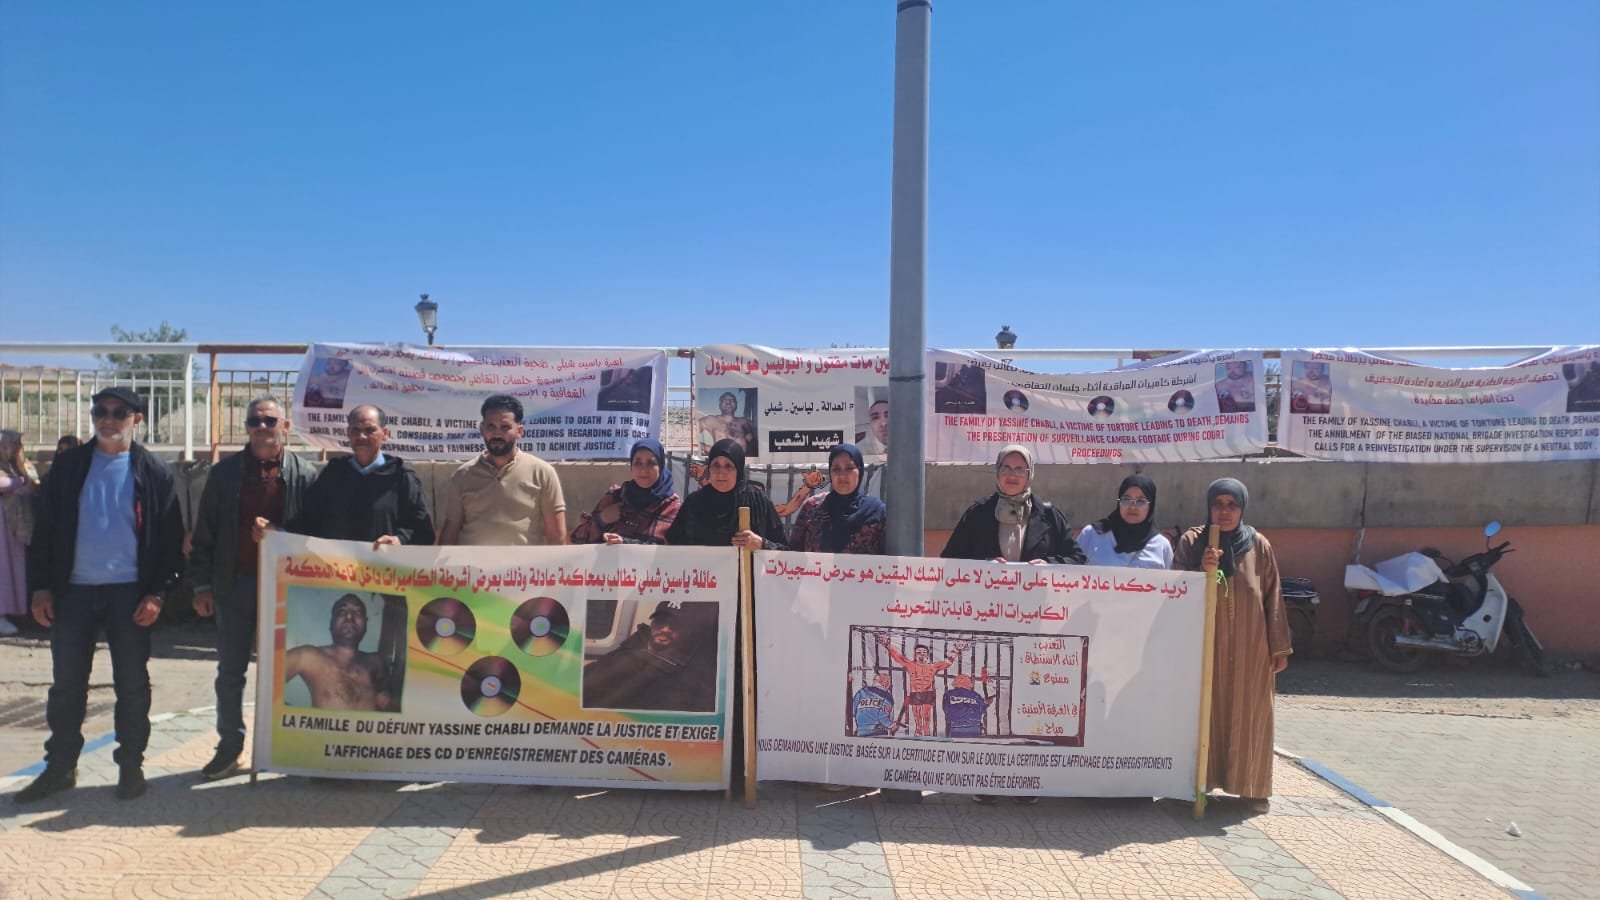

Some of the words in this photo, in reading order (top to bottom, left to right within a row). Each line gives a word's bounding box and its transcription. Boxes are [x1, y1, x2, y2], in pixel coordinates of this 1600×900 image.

[746, 360, 760, 374] هو
[762, 354, 803, 375] البوليس
[806, 362, 812, 374] و
[814, 354, 848, 374] مقتول
[850, 354, 872, 370] مات
[1102, 380, 1136, 391] المراقبة
[1138, 377, 1170, 389] كاميرات
[764, 400, 784, 416] شبلي
[790, 401, 814, 415] لياسين
[821, 400, 846, 412] العدالة
[308, 412, 320, 422] THE
[436, 418, 442, 428] A
[444, 418, 478, 429] VICTIME
[529, 416, 562, 425] LEADING
[564, 416, 575, 425] TO
[578, 416, 602, 425] DEATH
[607, 416, 616, 425] AT
[619, 416, 634, 426] THE
[945, 416, 958, 426] THE
[960, 416, 986, 427] FAMILY
[987, 417, 997, 428] OF
[999, 417, 1029, 428] YASSINE
[1066, 422, 1094, 431] VICTIME
[1096, 423, 1105, 431] OF
[1106, 422, 1139, 432] TORTURE
[1142, 420, 1173, 431] LEADING
[1175, 418, 1185, 428] TO
[1187, 416, 1211, 427] DEATH
[1302, 416, 1317, 425] THE
[1318, 416, 1345, 426] FAMILY
[1347, 417, 1357, 426] OF
[1360, 417, 1390, 427] YASSINE
[1460, 420, 1469, 428] OF
[1472, 418, 1506, 428] TORTURE
[1508, 416, 1537, 426] LEADING
[1539, 416, 1548, 426] TO
[396, 431, 443, 440] CONSIDERS
[568, 428, 612, 438] REGARDING
[614, 428, 629, 438] HIS
[774, 432, 808, 450] الشعب
[812, 432, 840, 450] شهيد
[967, 431, 981, 442] THE
[982, 431, 1038, 442] PRESENTATION
[1040, 432, 1049, 443] OF
[1051, 433, 1105, 444] SURVEILLANCE
[1106, 434, 1136, 444] CAMERA
[1138, 433, 1171, 444] FOOTAGE
[1174, 432, 1200, 442] DURING
[1202, 430, 1225, 440] COURT
[1308, 430, 1322, 438] THE
[1376, 430, 1386, 440] OF
[1388, 431, 1403, 440] THE
[1405, 431, 1432, 440] BIASED
[1434, 432, 1470, 440] NATIONAL
[1472, 431, 1504, 440] BRIGADE
[1504, 429, 1554, 440] INVESTIGATION
[428, 444, 444, 453] AND
[448, 443, 484, 453] FAIRNESS
[536, 442, 546, 452] TO
[549, 442, 582, 451] ACHIEVE
[584, 442, 616, 450] JUSTICE
[1314, 442, 1338, 451] CALLS
[1340, 443, 1355, 452] FOR
[1365, 443, 1432, 453] REINVESTIGATION
[1433, 444, 1458, 453] UNDER
[1460, 444, 1474, 453] THE
[1476, 444, 1522, 453] SUPERVISION
[1524, 443, 1533, 452] OF
[285, 556, 333, 579] المحكمة
[334, 562, 356, 584] قاعة
[360, 565, 382, 587] داخل
[765, 559, 822, 580] تسجيلات
[823, 564, 856, 582] عرض
[860, 568, 874, 584] هو
[875, 564, 912, 584] اليقين
[914, 566, 944, 582] الشك
[973, 568, 983, 585] لا
[383, 566, 436, 592] الكاميرات
[439, 565, 471, 592] أشرطة
[472, 568, 502, 593] بعرض
[503, 567, 527, 592] وذلك
[529, 568, 556, 587] عادلة
[558, 568, 606, 592] بمحاكمة
[607, 568, 636, 592] تطالب
[638, 568, 661, 594] شبلي
[662, 569, 691, 594] ياسين
[692, 568, 717, 589] عائلة
[946, 568, 971, 588] على
[985, 570, 1022, 591] اليقين
[1023, 572, 1048, 592] على
[1052, 572, 1079, 593] مبنيا
[1082, 574, 1110, 591] عادلا
[1114, 576, 1157, 593] حكما
[1161, 580, 1188, 598] نريد
[887, 600, 940, 618] للتحريف
[942, 600, 972, 620] قابلة
[974, 602, 1003, 622] الغير
[1005, 602, 1069, 624] الكاميرات
[282, 714, 296, 728] LA
[299, 716, 350, 732] FAMILLE
[356, 720, 374, 734] DU
[377, 718, 426, 735] DÉFUNT
[429, 723, 482, 736] YASSINE
[484, 722, 530, 735] CHABLI
[534, 722, 594, 737] DEMANDE
[597, 723, 610, 737] LA
[614, 724, 661, 739] JUSTICE
[664, 726, 680, 739] ET
[681, 726, 718, 740] EXIGE
[324, 744, 403, 760] L'AFFICHAGE
[407, 747, 432, 760] DES
[435, 748, 452, 760] CD
[456, 748, 578, 763] D'ENREGISTREMENT
[580, 750, 604, 764] DES
[774, 740, 814, 755] DEMANDONS
[815, 742, 828, 755] UNE
[829, 743, 853, 758] JUSTICE
[856, 742, 877, 759] BASÉE
[878, 746, 892, 760] SUR
[892, 748, 900, 760] LA
[902, 749, 936, 763] CERTITUDE
[937, 750, 945, 763] ET
[946, 750, 960, 764] NON
[961, 752, 976, 764] SUR
[976, 753, 984, 765] LE
[985, 753, 1007, 766] DOUTE
[1007, 754, 1015, 766] LA
[1016, 754, 1050, 767] CERTITUDE
[1050, 755, 1060, 768] EST
[1062, 755, 1101, 769] L'AFFICHAGE
[1102, 756, 1115, 769] DES
[1116, 756, 1173, 770] ENREGISTREMENTS
[884, 768, 894, 781] DE
[895, 767, 921, 782] CAMÉRA
[922, 771, 934, 785] QUI
[935, 772, 944, 785] NE
[946, 772, 975, 787] POUVENT
[976, 774, 988, 788] PAS
